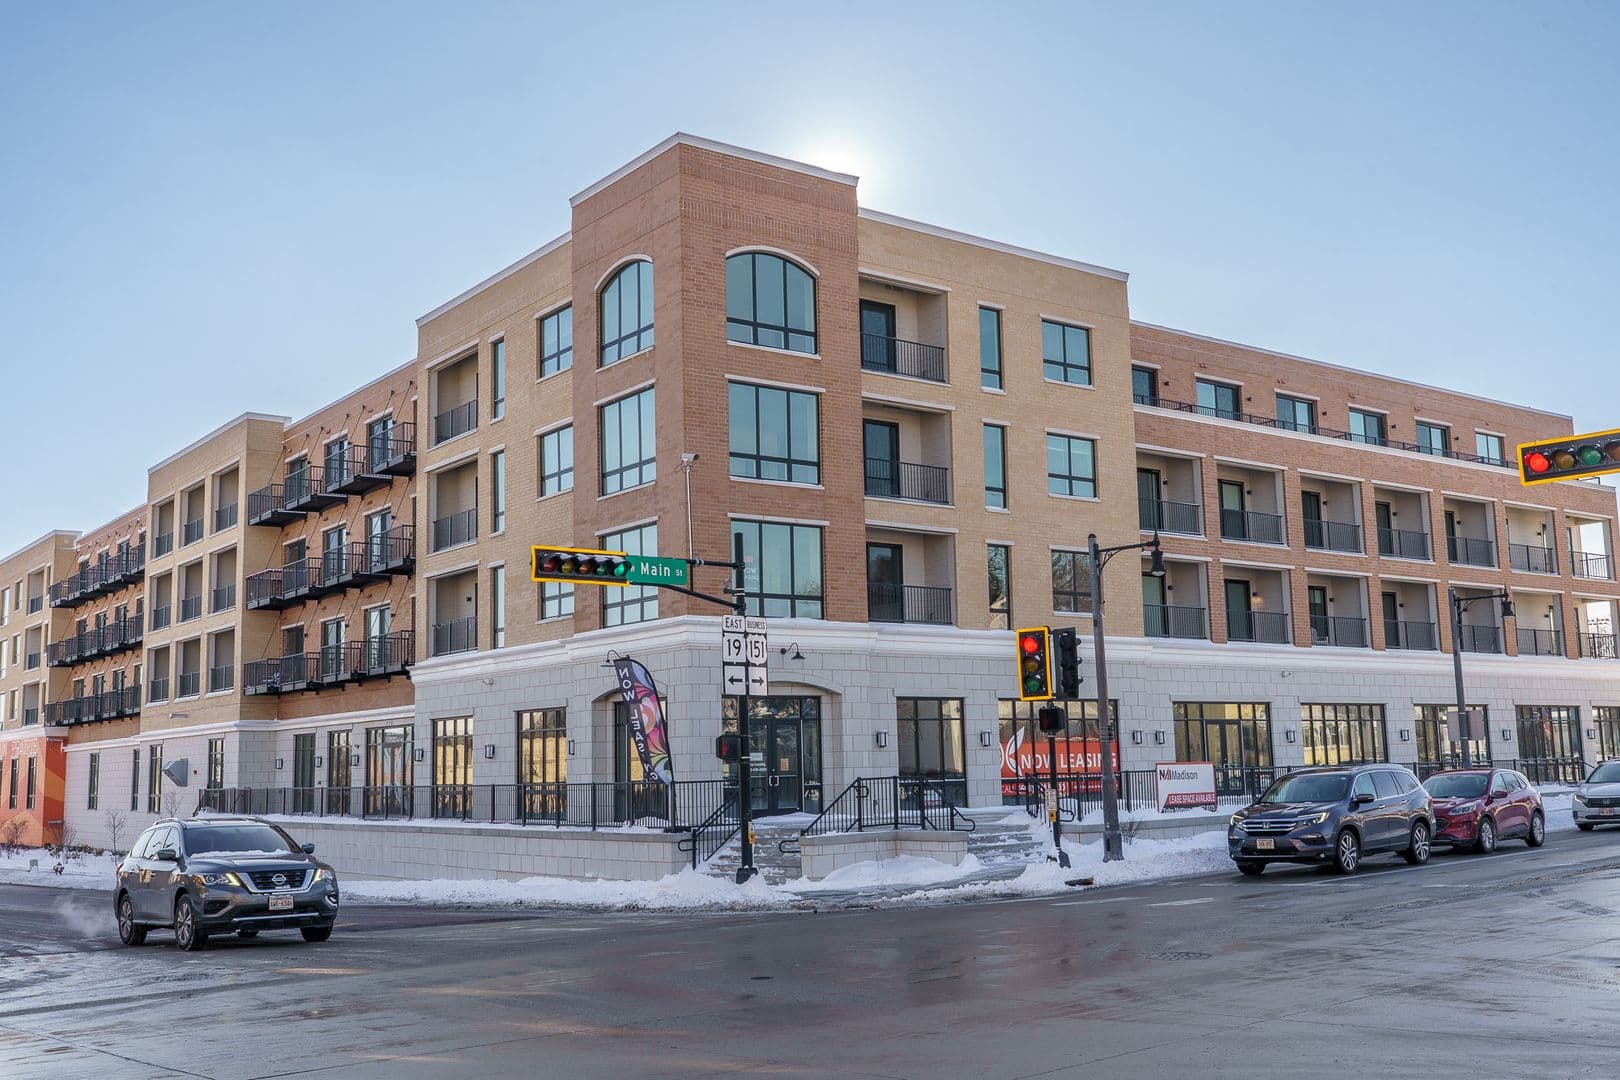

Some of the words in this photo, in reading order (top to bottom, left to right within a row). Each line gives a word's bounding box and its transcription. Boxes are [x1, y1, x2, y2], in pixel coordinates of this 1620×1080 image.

[640, 562, 671, 577] Main
[675, 569, 683, 577] St
[725, 617, 742, 629] EAST
[727, 638, 741, 657] 19
[750, 640, 765, 659] 151
